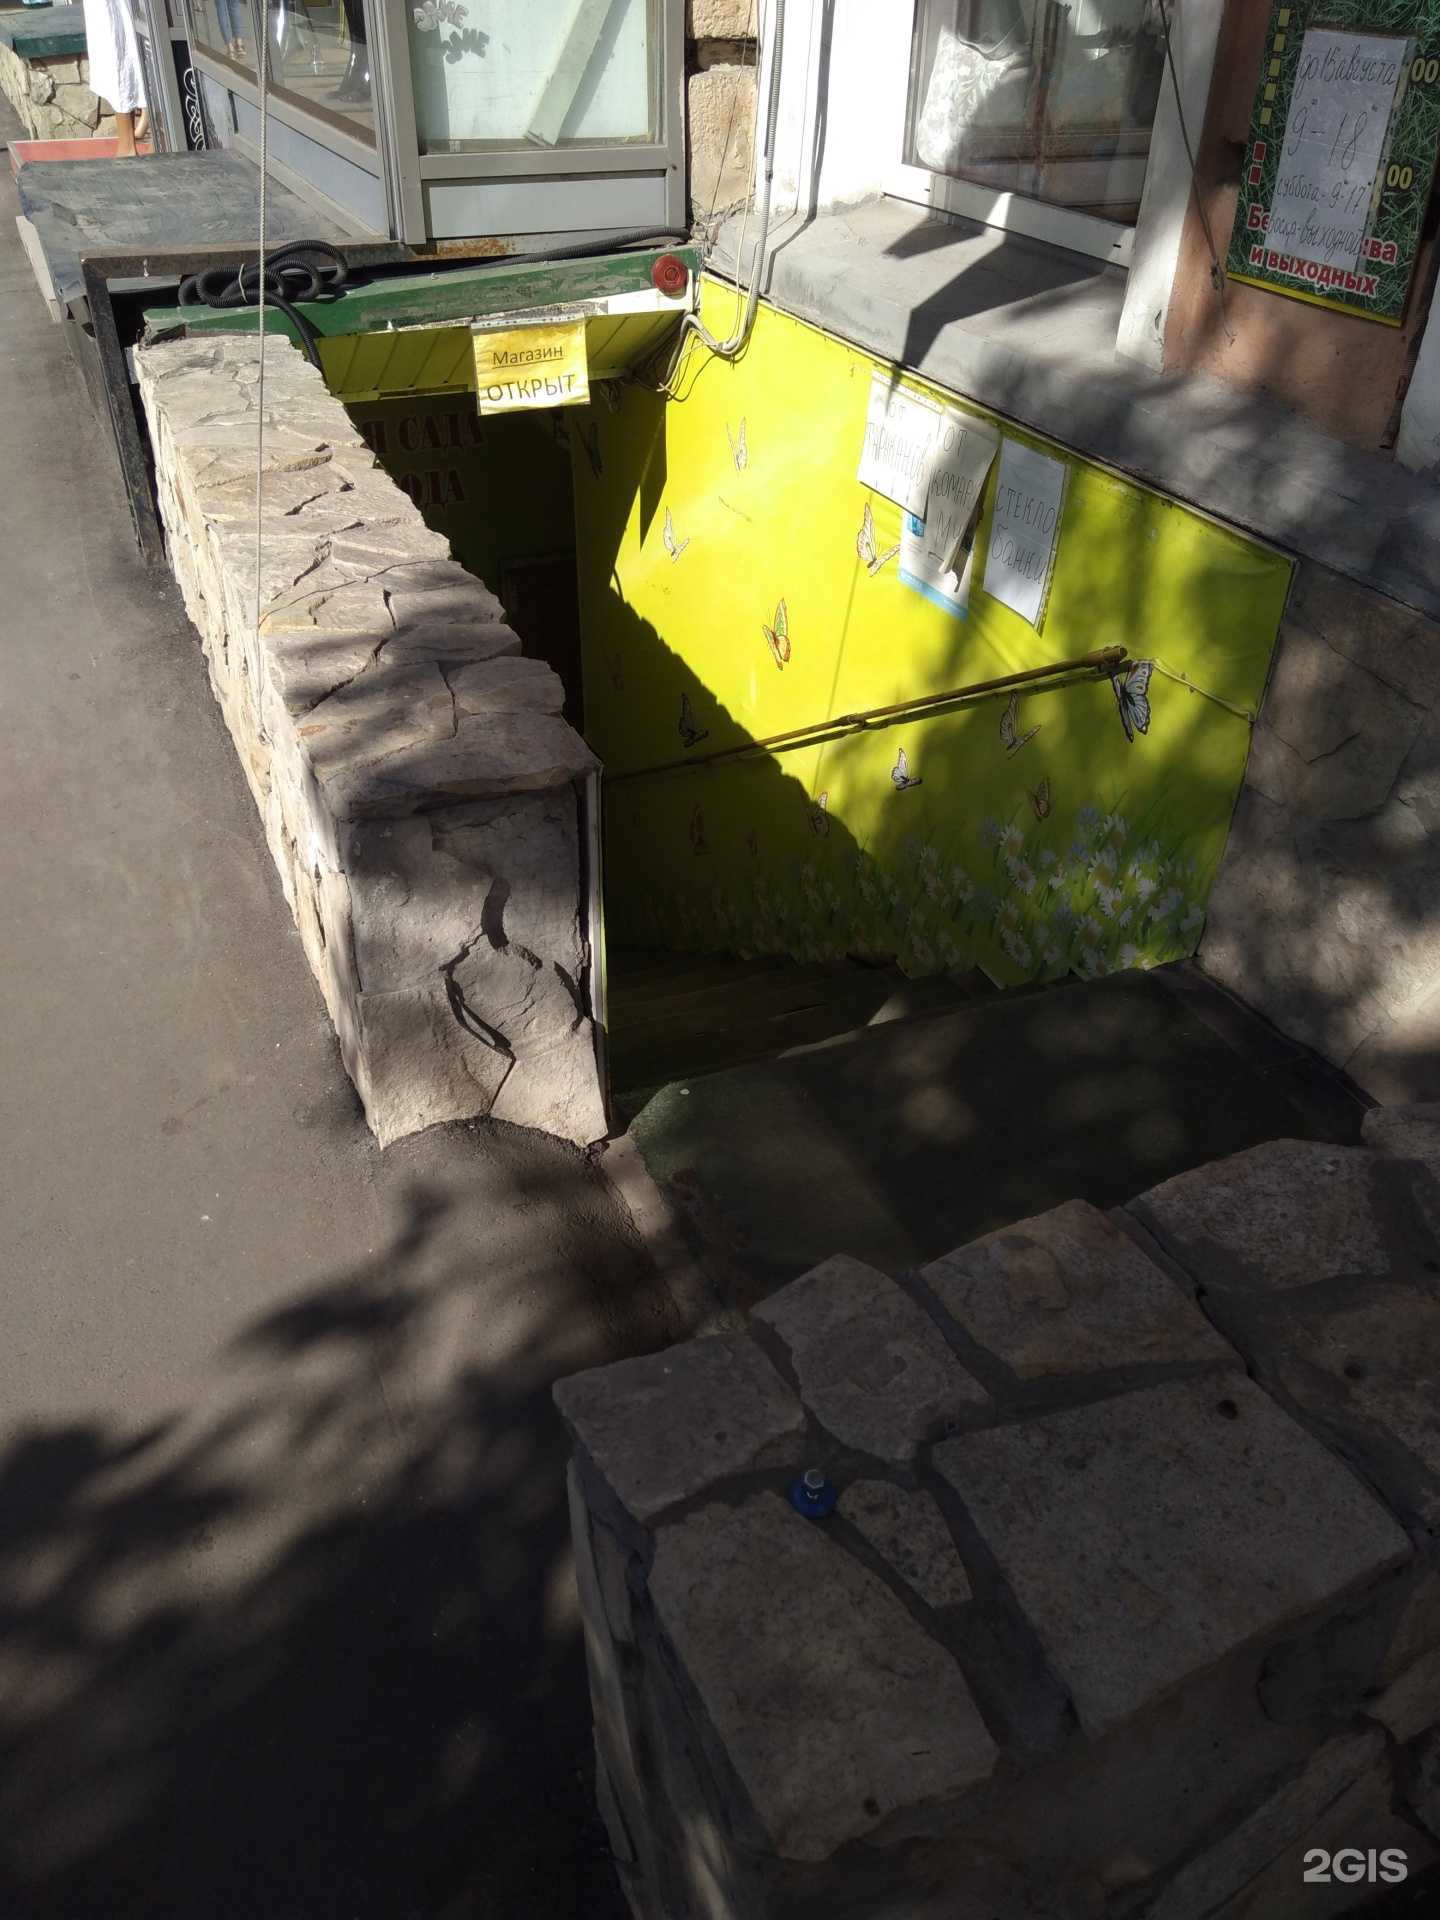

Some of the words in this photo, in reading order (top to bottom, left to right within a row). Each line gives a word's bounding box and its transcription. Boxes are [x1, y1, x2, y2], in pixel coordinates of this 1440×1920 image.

[1411, 57, 1439, 84] 00
[1386, 164, 1414, 190] 00
[1247, 203, 1270, 233] Бе
[493, 345, 564, 366] Магазин
[487, 374, 575, 401] ОТКРЫТ
